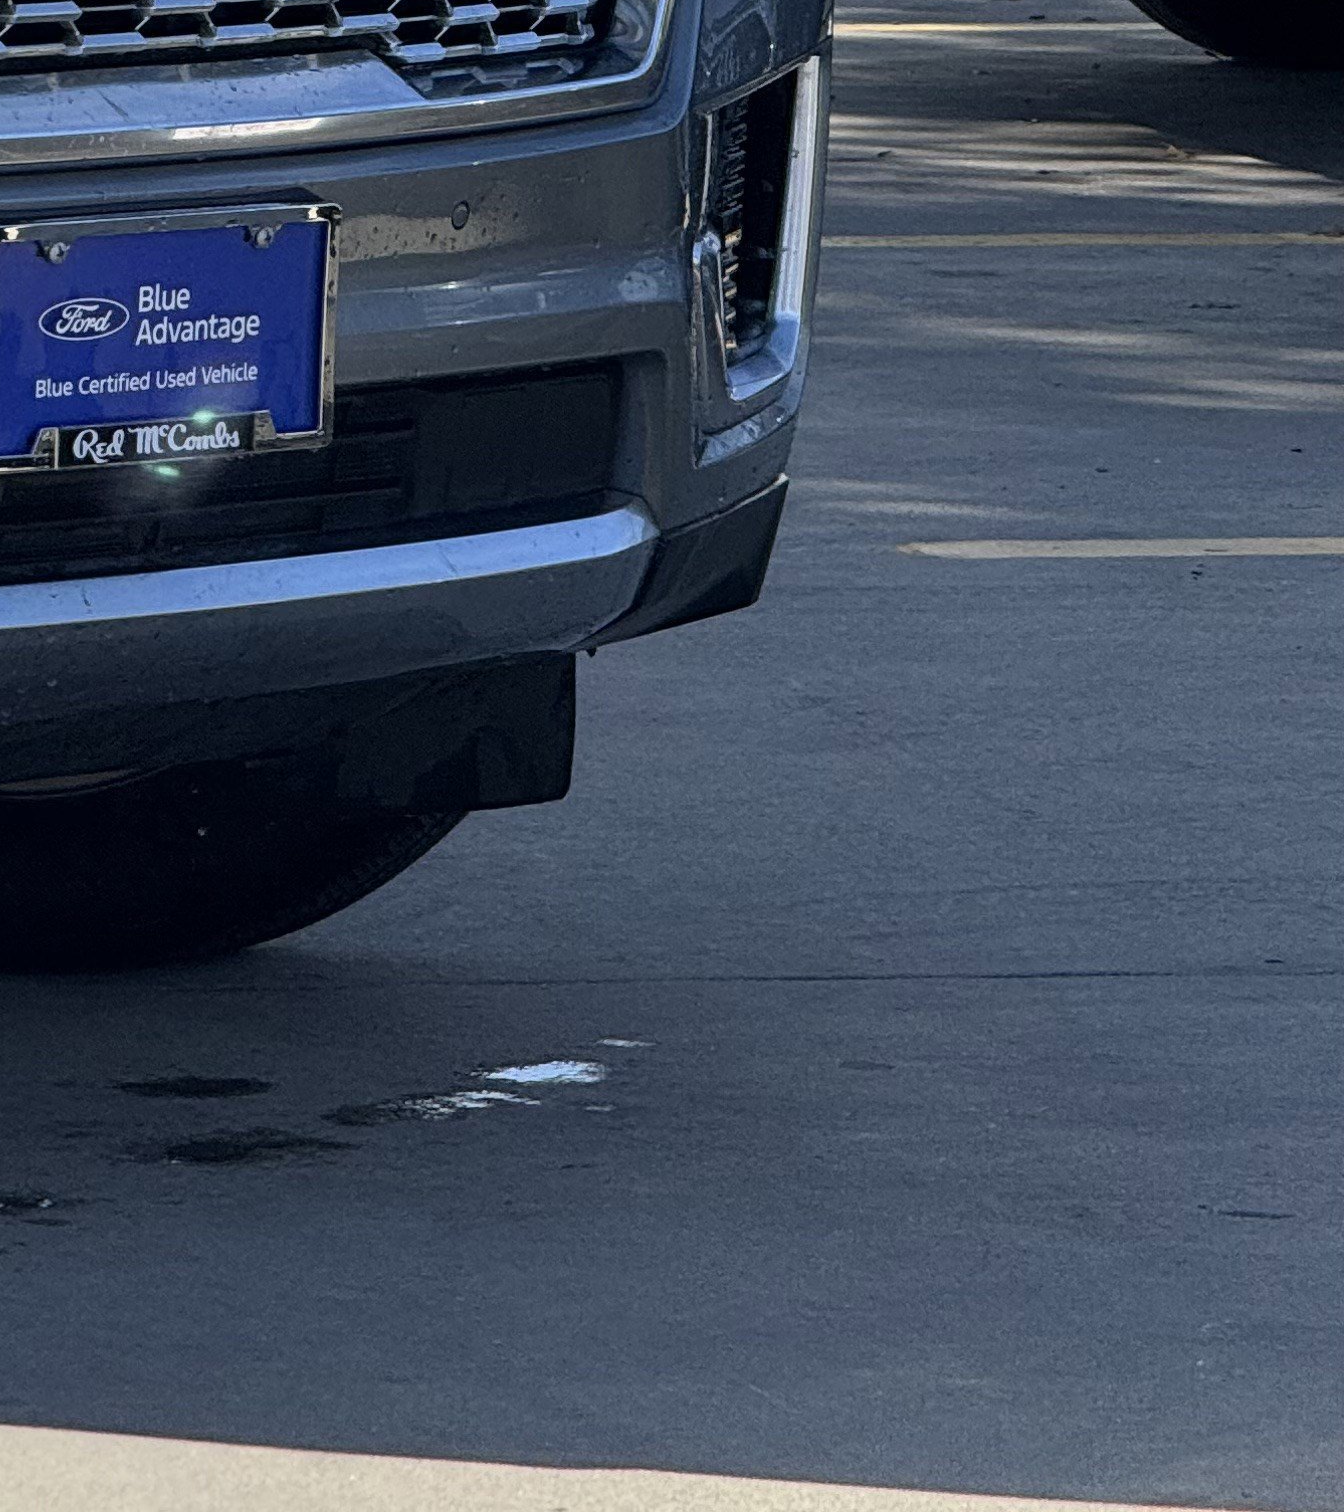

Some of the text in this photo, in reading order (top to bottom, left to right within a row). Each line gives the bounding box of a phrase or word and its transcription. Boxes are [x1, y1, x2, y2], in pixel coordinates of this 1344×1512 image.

[138, 283, 190, 312] Blue
[55, 303, 113, 335] Ford
[135, 311, 261, 347] Advantage
[35, 362, 258, 399] Blue Certified Used Vehicle
[72, 428, 125, 464] Red
